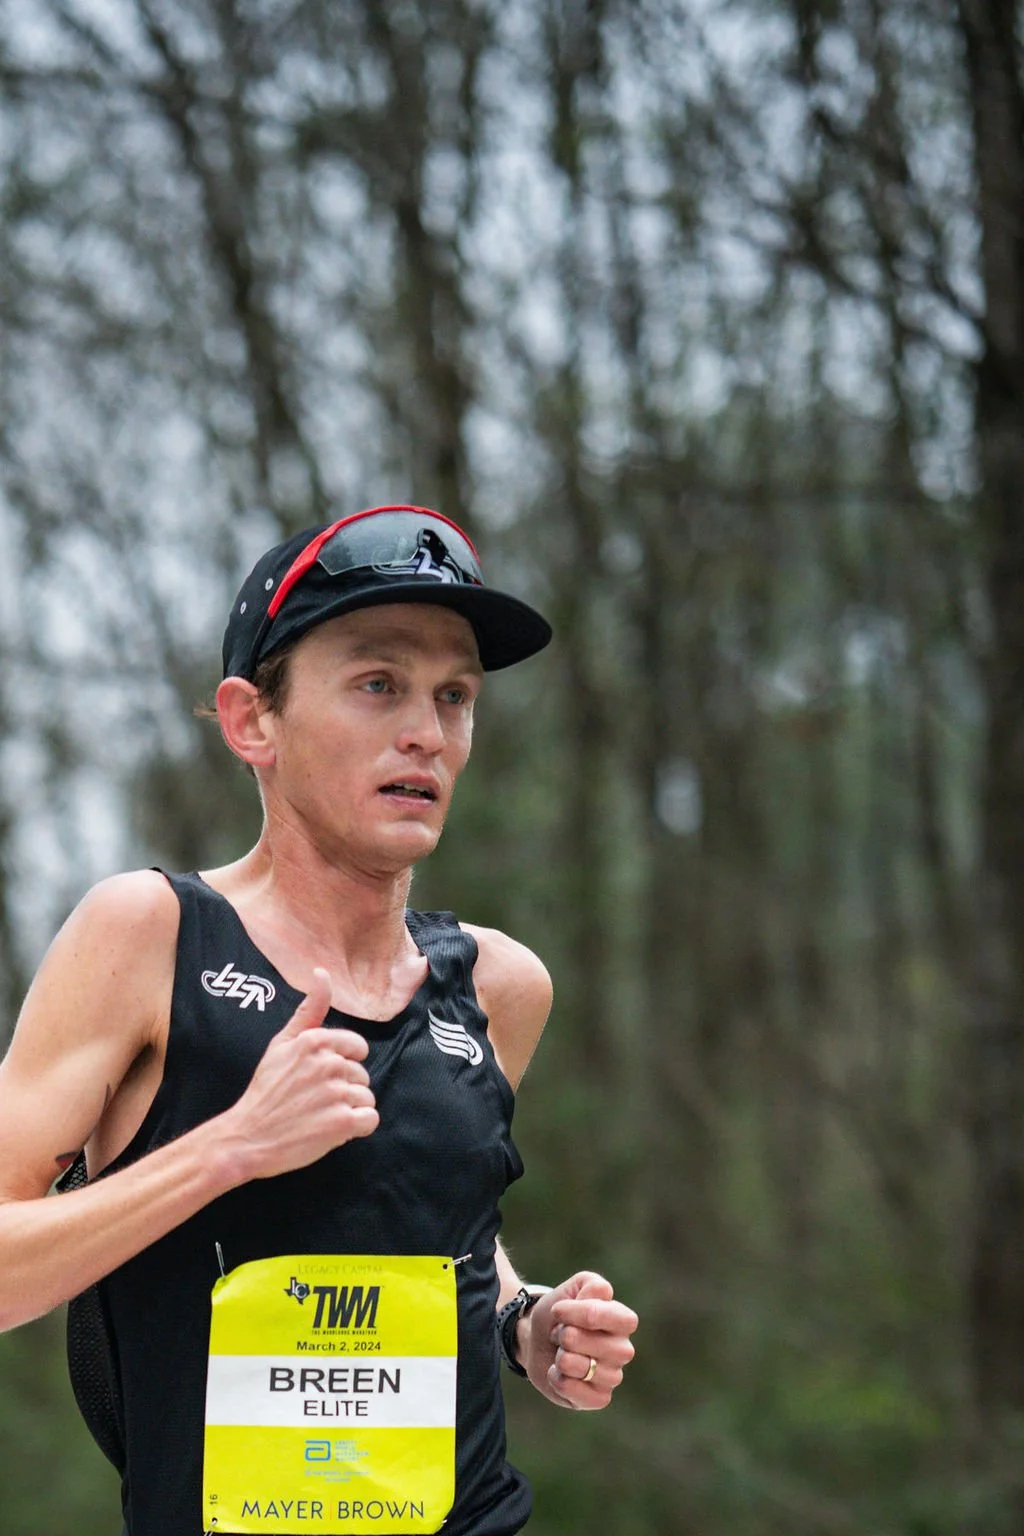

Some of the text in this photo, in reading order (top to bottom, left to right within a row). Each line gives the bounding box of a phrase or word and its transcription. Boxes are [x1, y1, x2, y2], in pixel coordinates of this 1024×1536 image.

[296, 1341, 381, 1353] March 2, 2024
[269, 1367, 401, 1393] BREEN
[303, 1400, 369, 1417] ELITE
[241, 1499, 425, 1519] MAYER BROWN
